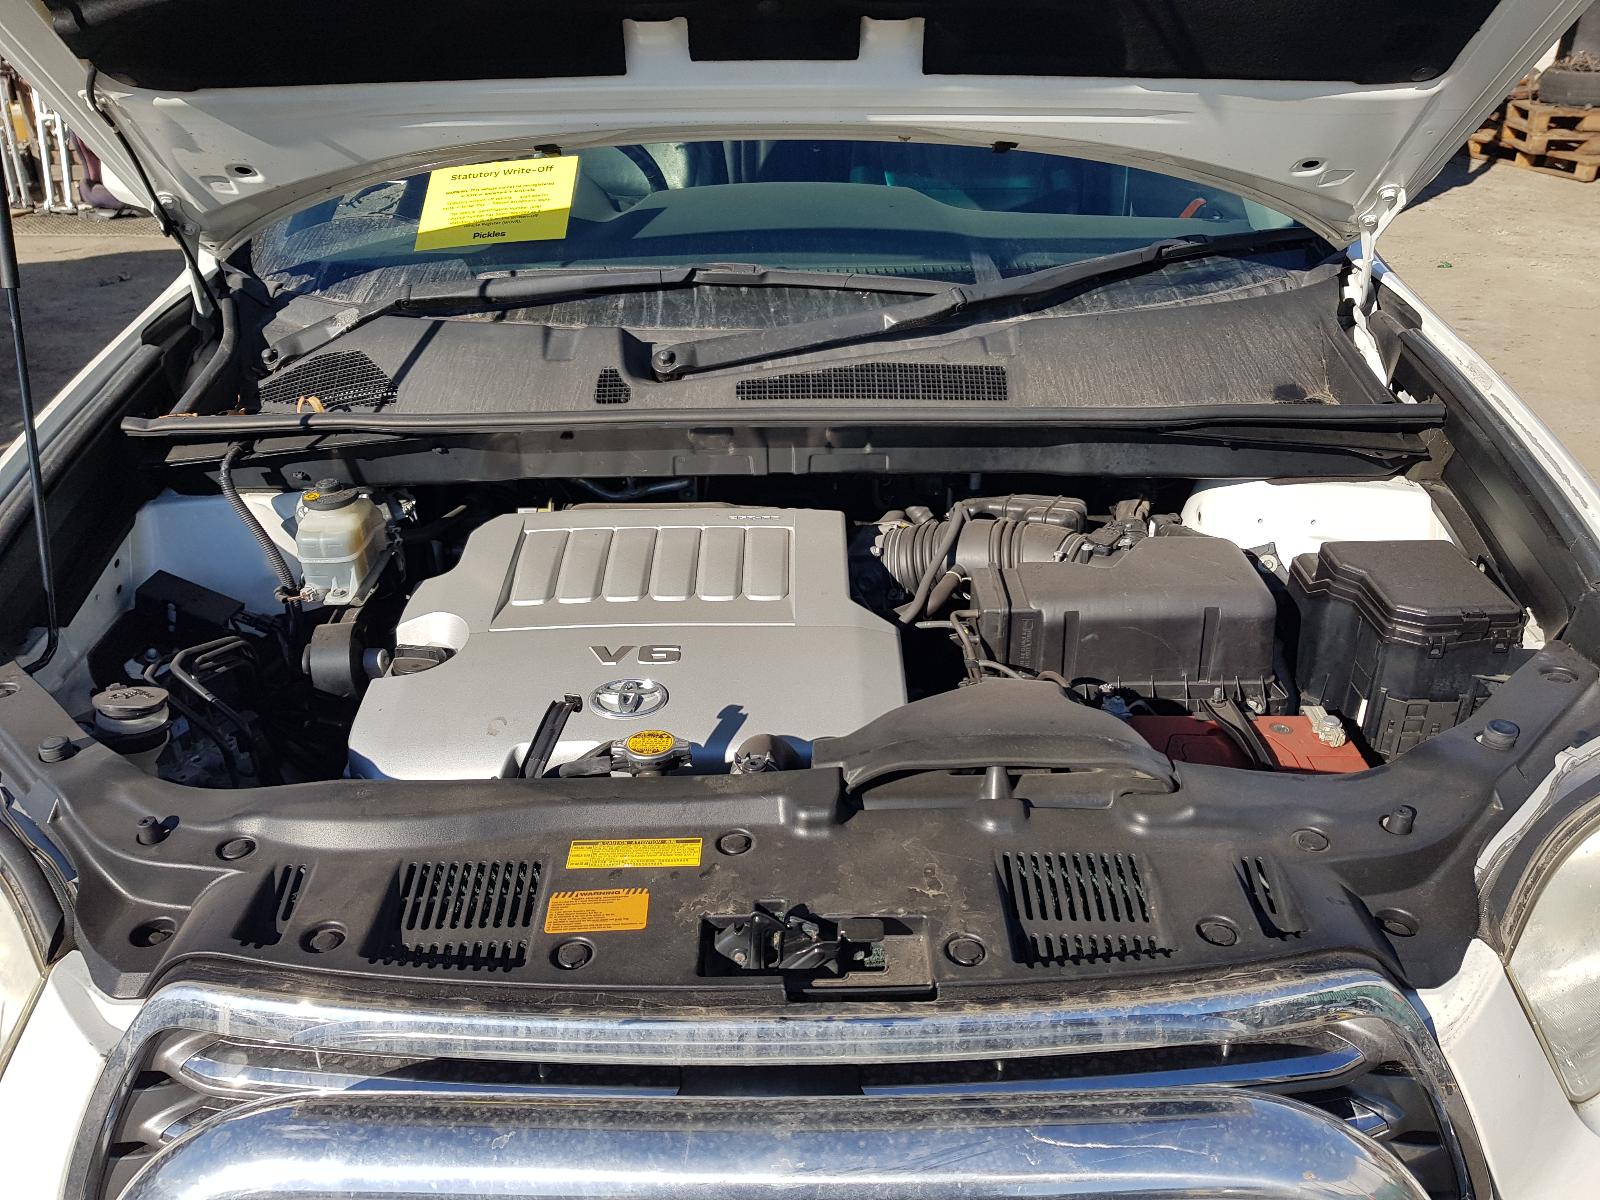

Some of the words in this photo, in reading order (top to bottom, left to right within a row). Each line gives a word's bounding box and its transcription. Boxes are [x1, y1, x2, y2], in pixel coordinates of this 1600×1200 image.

[450, 170, 500, 181] Statutory
[503, 164, 554, 176] Write-Off
[472, 230, 507, 240] Pickles
[588, 645, 682, 665] V6
